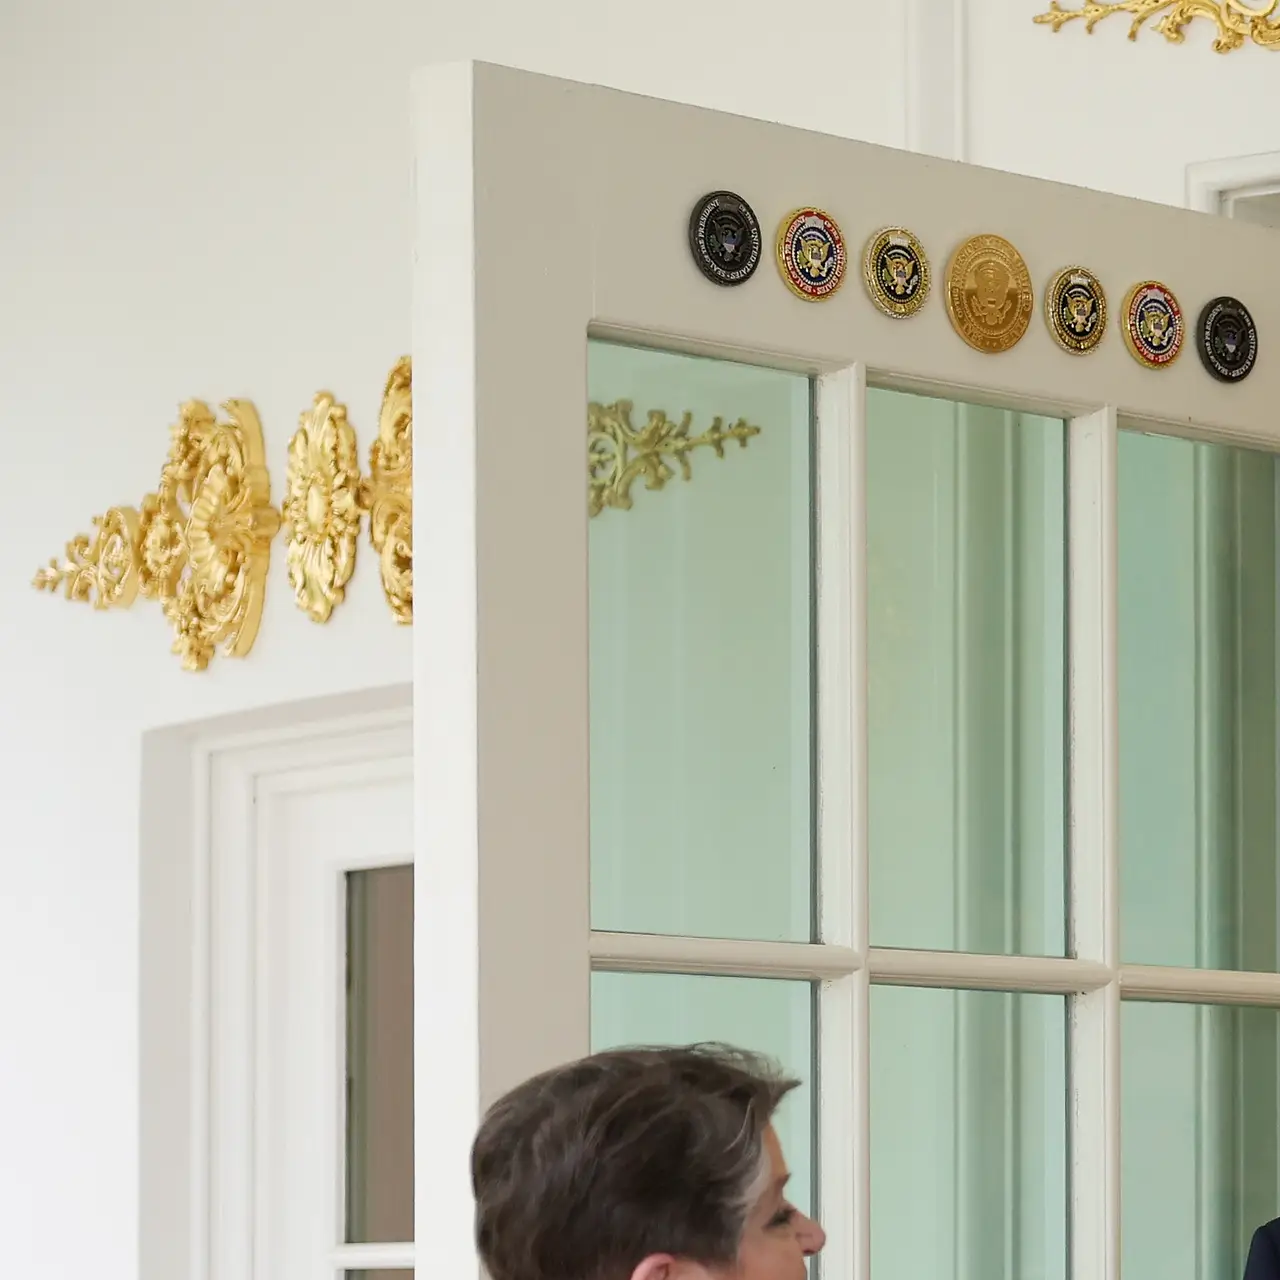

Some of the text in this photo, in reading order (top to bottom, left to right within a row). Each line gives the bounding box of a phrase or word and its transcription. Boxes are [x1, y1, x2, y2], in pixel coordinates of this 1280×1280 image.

[698, 199, 720, 238] PRESIDENT
[750, 228, 759, 263] UNITED
[710, 261, 727, 278] SEAL
[731, 261, 754, 280] STATES
[835, 243, 844, 277] UNITED
[795, 278, 812, 293] SEAL
[817, 276, 839, 295] STATES
[1248, 328, 1256, 361] UNITED
